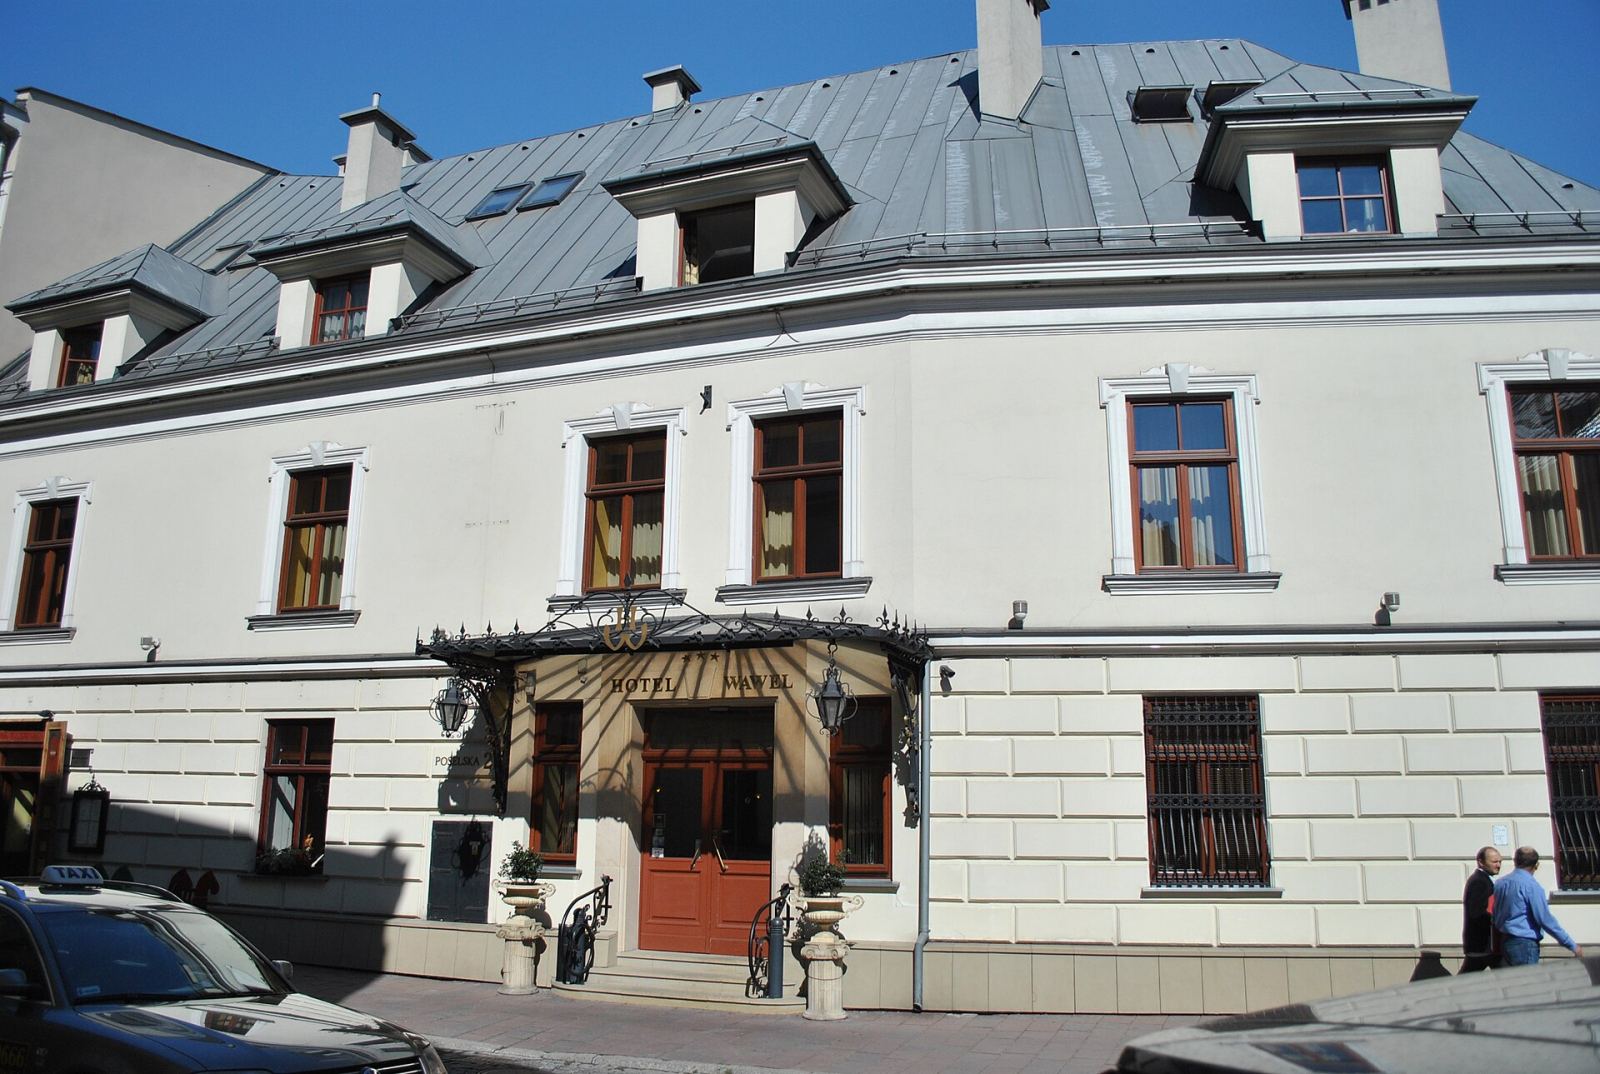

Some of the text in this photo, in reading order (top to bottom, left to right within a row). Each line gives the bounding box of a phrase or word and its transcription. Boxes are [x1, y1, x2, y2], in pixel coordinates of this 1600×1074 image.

[611, 673, 794, 694] HOTEL WAWEL
[435, 756, 480, 767] POSELSKA
[52, 867, 100, 879] TAXI
